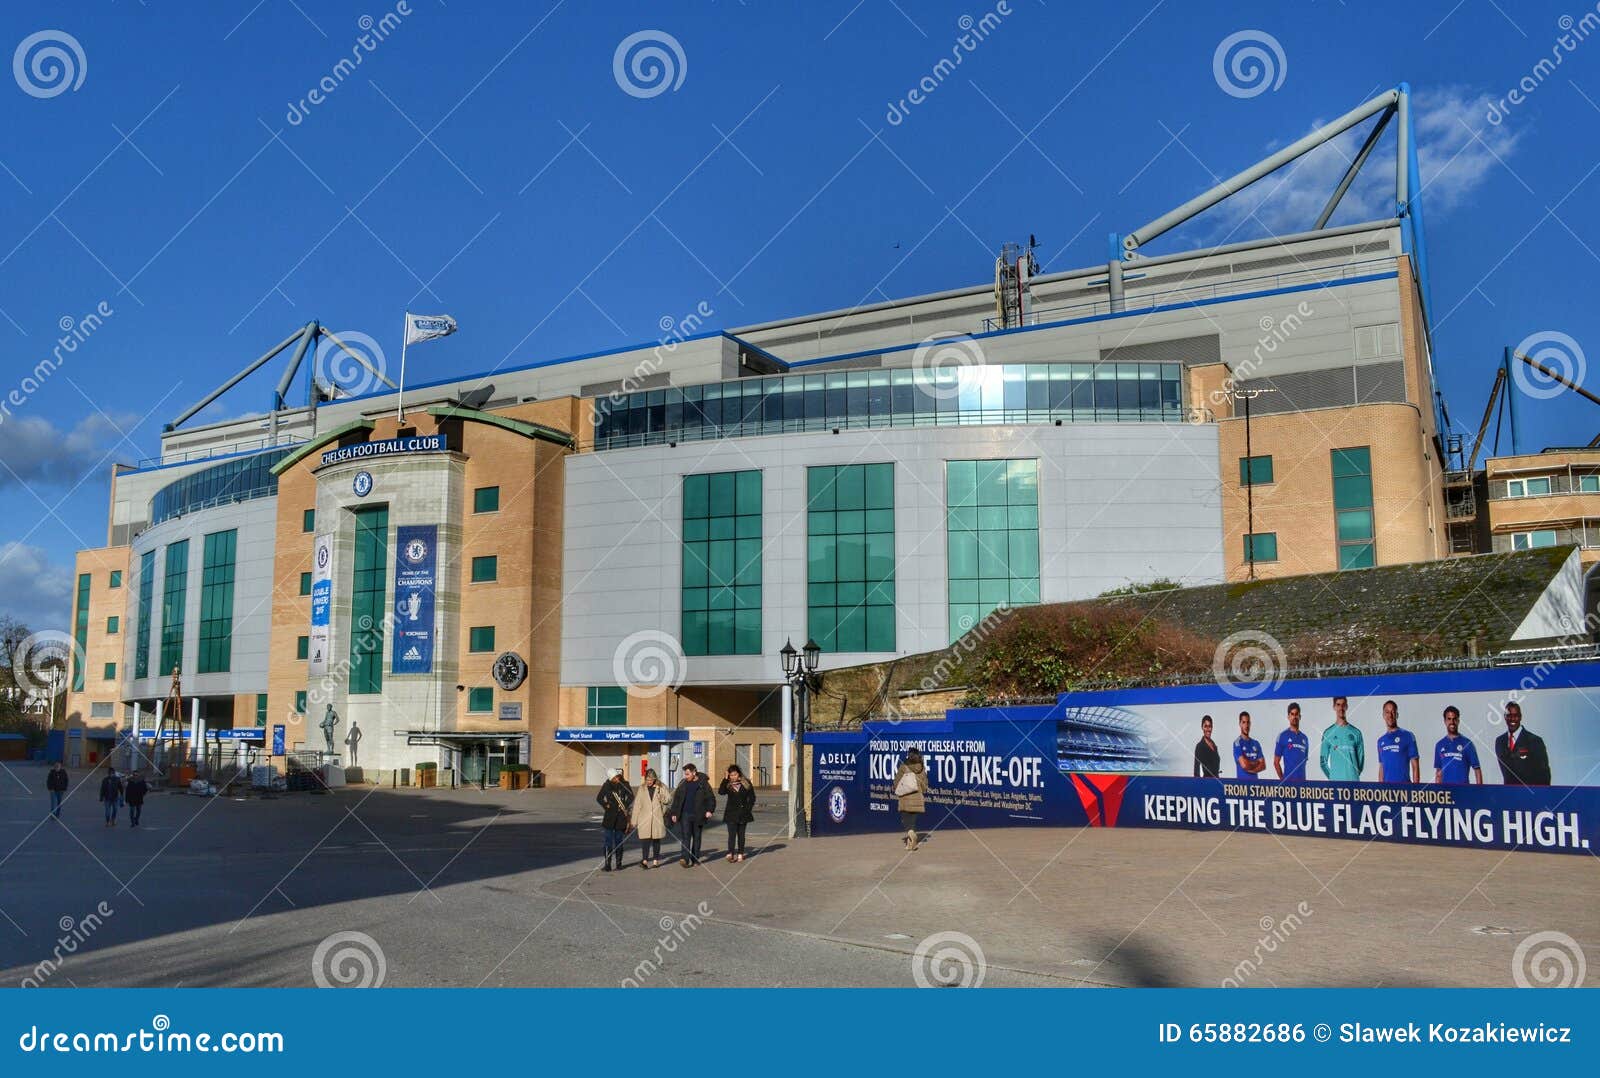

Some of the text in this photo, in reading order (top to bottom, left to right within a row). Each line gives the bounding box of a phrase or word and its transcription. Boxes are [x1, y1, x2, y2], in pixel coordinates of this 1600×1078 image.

[321, 438, 439, 465] CHELSEA FOOTBALL CLUB
[606, 732, 620, 740] Upper
[869, 740, 985, 753] PROUD TO SUPPORT CHELSEA FC FROM
[828, 753, 856, 764] DELTA
[869, 754, 1044, 788] KICKF TO TAKE-OFF.
[1224, 785, 1455, 804] FROM STAMFORD BRIDGE TO BROOKLYN BRIDGE.
[1144, 794, 1589, 848] KEEPING THE BLUE FLAG FLYING HIGH.
